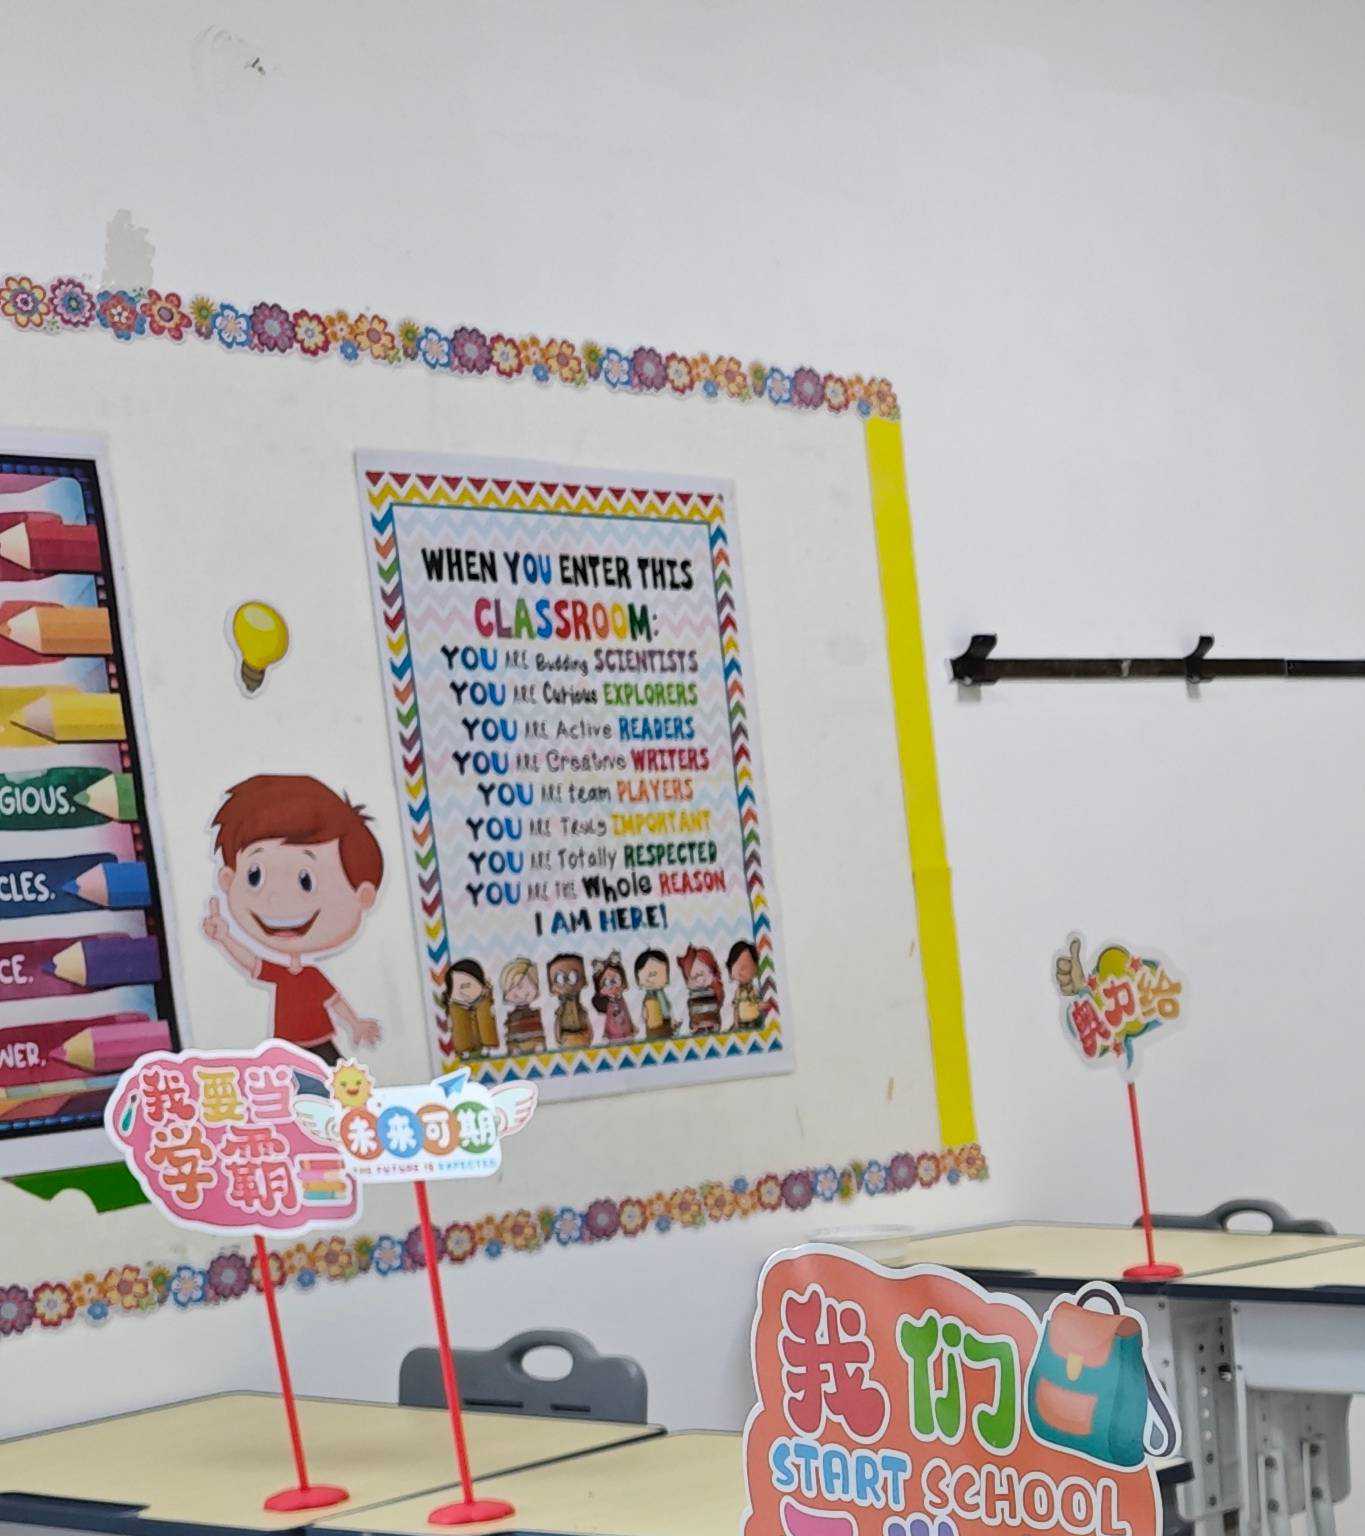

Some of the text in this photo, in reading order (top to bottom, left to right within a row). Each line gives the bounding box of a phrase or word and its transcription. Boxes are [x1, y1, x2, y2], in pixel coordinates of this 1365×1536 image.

[421, 548, 694, 591] WHEN YOU ENTER THIS
[475, 598, 660, 643] CLASSROOM:
[441, 645, 497, 671] YOU
[594, 648, 699, 674] SCIENTISTS
[450, 681, 506, 706] YOU
[543, 682, 597, 705] Curious
[603, 683, 698, 706] EXPLORERS
[462, 717, 517, 742] YOU
[556, 720, 612, 740] Active
[618, 716, 695, 741] READERS
[452, 750, 509, 775] YOU
[546, 750, 627, 772] Creative
[631, 748, 709, 771] WRITERS
[477, 782, 534, 806] YOU
[568, 784, 612, 803] team
[616, 779, 694, 803] PLAYERS
[466, 817, 522, 841] YOU
[611, 809, 712, 837] IMPORTANT
[468, 850, 524, 875] YOU
[558, 847, 618, 871] Totally
[624, 841, 718, 868] RESPECTED
[466, 881, 522, 907] YOU
[582, 872, 652, 904] Whole
[658, 869, 726, 898] REASON
[535, 903, 668, 937] I AM HERE!
[142, 1067, 297, 1123] 我要当
[348, 1108, 498, 1155] 未来可期
[150, 1125, 298, 1215] 学霸
[782, 1292, 1015, 1448] 我们
[772, 1444, 908, 1505] START
